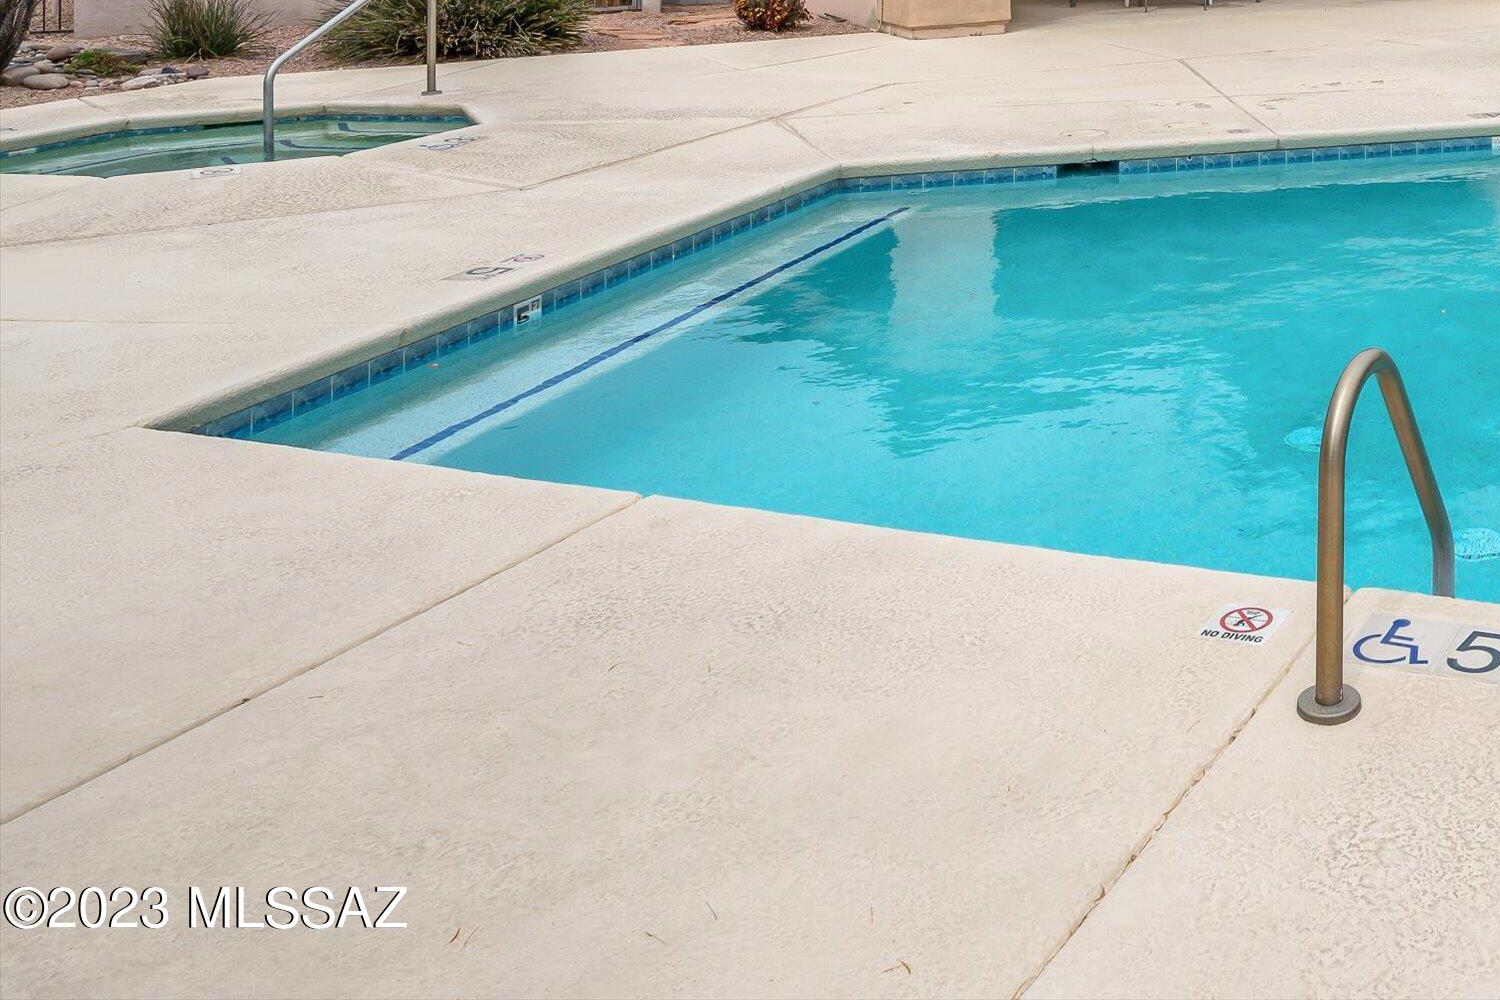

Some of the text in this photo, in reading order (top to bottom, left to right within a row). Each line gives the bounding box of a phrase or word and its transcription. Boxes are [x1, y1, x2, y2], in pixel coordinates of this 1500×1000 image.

[517, 304, 530, 325] 5
[1200, 629, 1264, 643] NO DIVING
